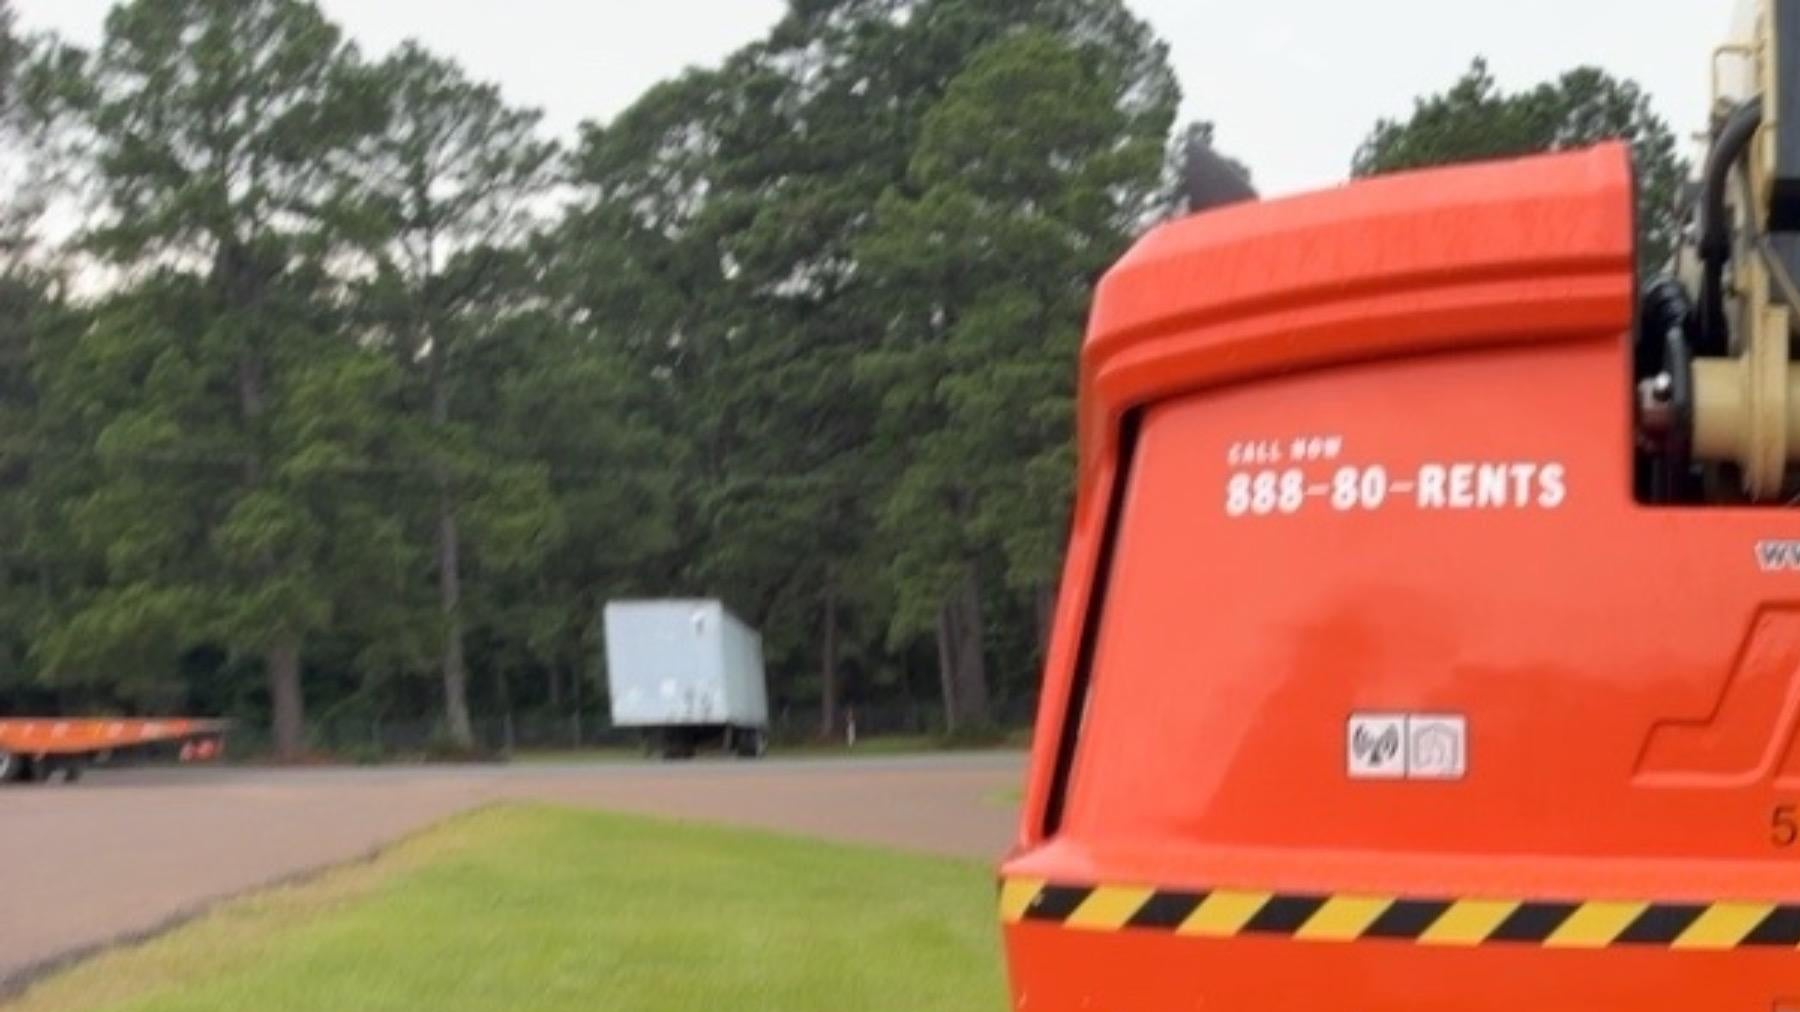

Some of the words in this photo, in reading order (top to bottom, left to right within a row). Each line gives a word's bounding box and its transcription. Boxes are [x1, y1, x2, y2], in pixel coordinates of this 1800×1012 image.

[1227, 440, 1282, 466] CALL
[1290, 435, 1342, 460] NOW
[1225, 463, 1567, 516] 888-80-RENTS
